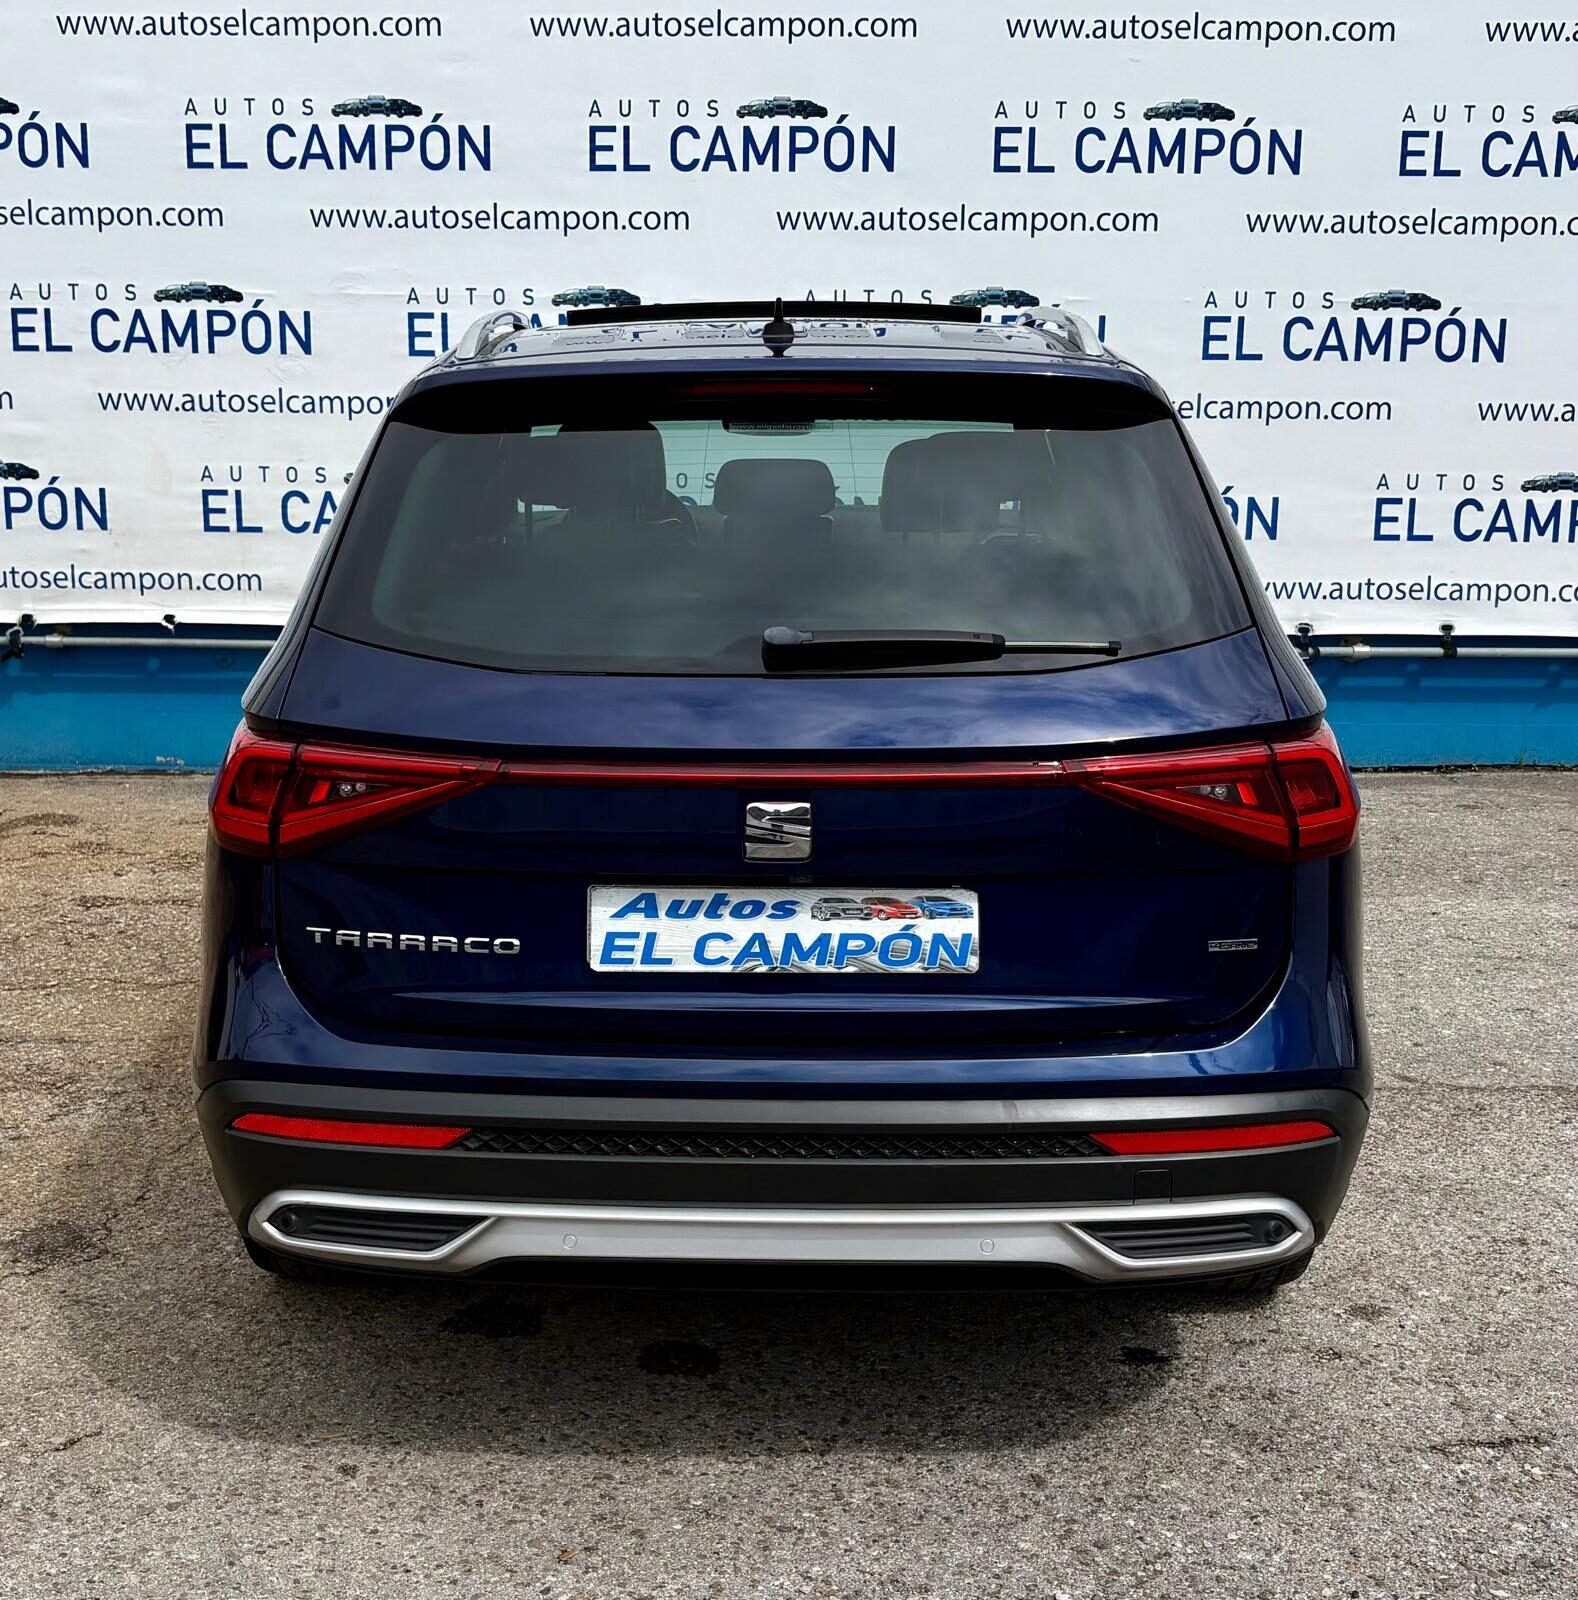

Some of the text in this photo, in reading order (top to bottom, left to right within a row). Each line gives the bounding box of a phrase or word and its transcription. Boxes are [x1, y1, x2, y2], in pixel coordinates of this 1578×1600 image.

[55, 8, 442, 44] www.autoselcampon.com
[529, 8, 917, 45] www.autoselcampon.com
[1005, 11, 1396, 49] www.autoselcampon.com
[184, 97, 314, 116] AUTOS
[588, 99, 719, 118] AUTOS
[994, 100, 1126, 120] AUTOS
[1401, 104, 1535, 124] AUTOS
[185, 114, 491, 170] EL CAMPÓN
[588, 115, 895, 172] EL CAMPÓN
[992, 117, 1302, 174] EL CAMPÓN
[1398, 130, 1462, 177] EL
[309, 202, 690, 238] www.autoselcampon.com
[776, 203, 1159, 239] www.autoselcampon.com
[9, 282, 137, 302] AUTOS
[406, 287, 535, 306] AUTOS
[1204, 290, 1334, 310] AUTOS
[10, 299, 312, 355] EL CAMPÓN
[1201, 307, 1507, 363] EL CAMPÓN
[1173, 393, 1391, 425] elcampon.com
[200, 465, 327, 484] AUTOS
[1375, 473, 1504, 492] AUTOS
[3, 476, 108, 531] PÓN
[201, 488, 264, 534] EL
[1373, 497, 1434, 542] EL
[1265, 576, 1578, 608] ww.autoselcampon.c
[609, 892, 799, 920] Autos
[306, 926, 520, 954] TARRACO
[599, 924, 973, 968] EL CAMPÓN
